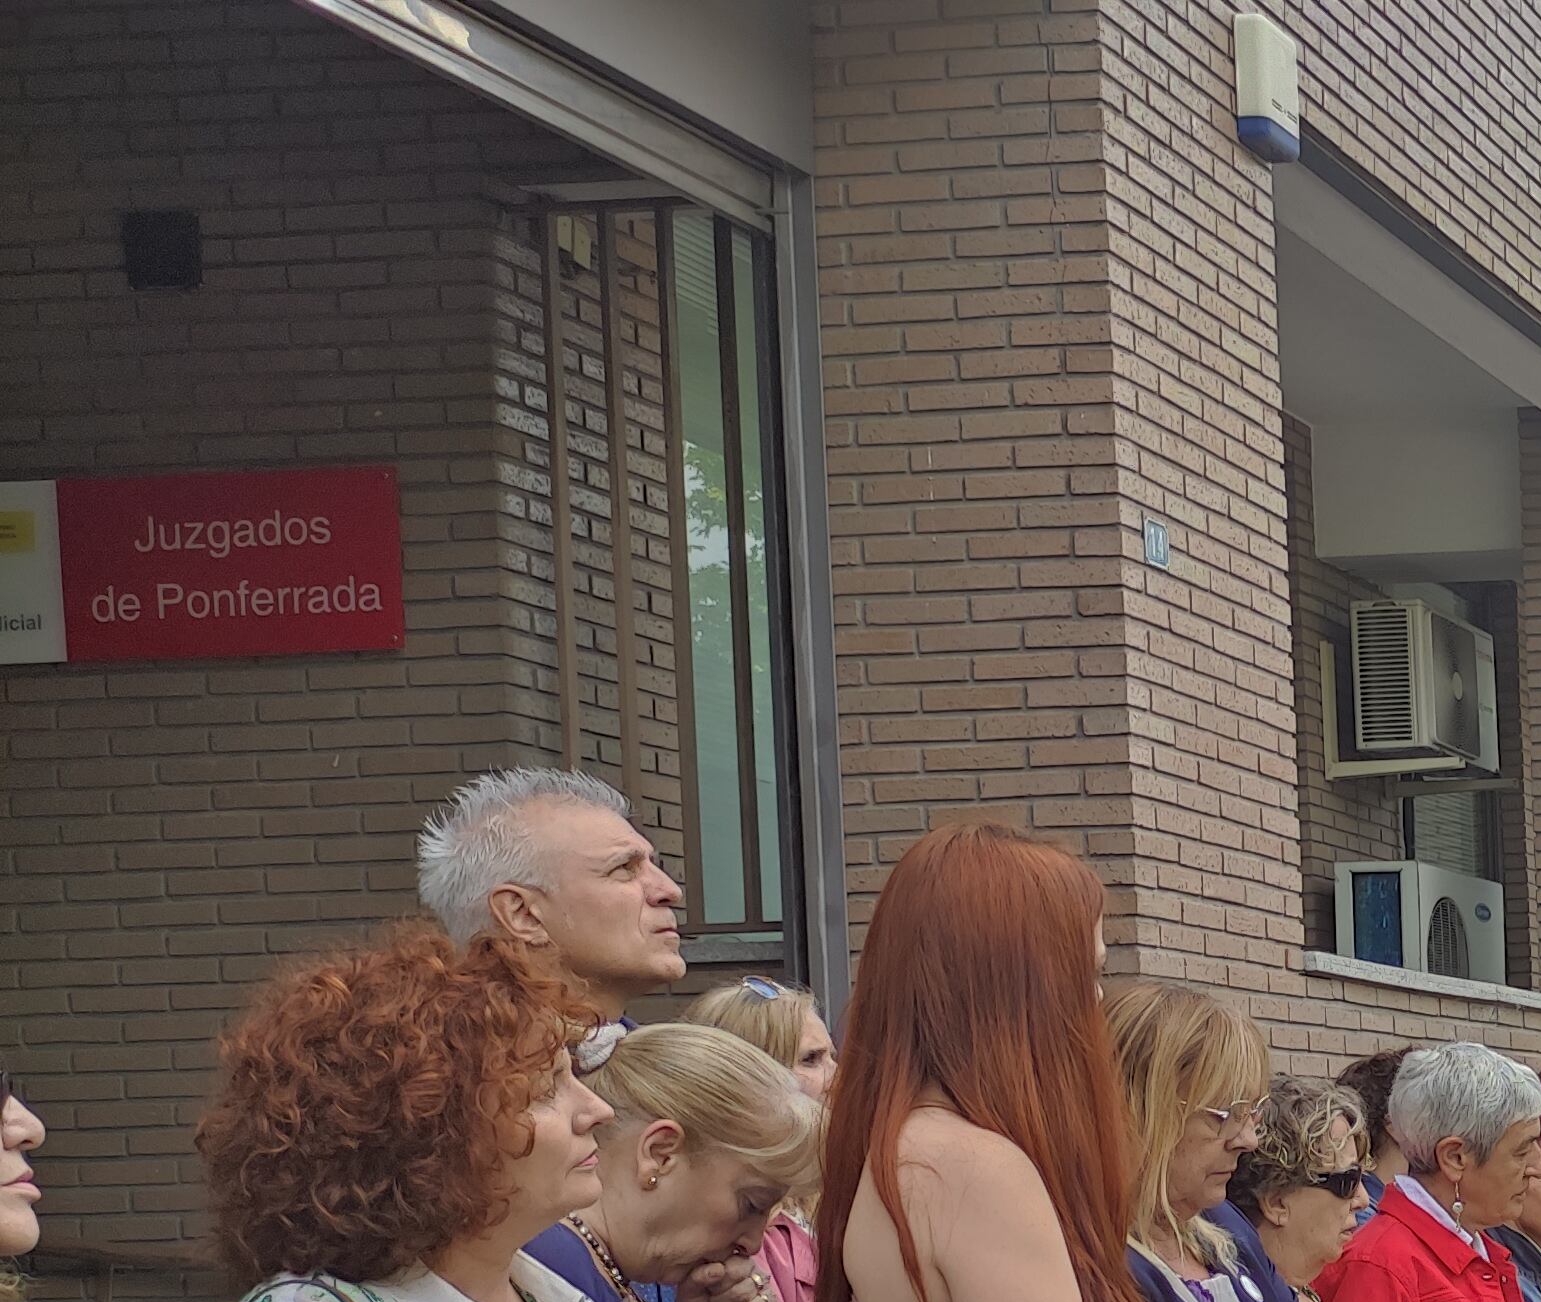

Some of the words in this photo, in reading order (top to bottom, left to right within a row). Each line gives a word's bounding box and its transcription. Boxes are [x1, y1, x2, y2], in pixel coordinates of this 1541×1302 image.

[134, 509, 332, 558] Juzgados
[91, 584, 142, 623] de
[156, 575, 383, 620] Ponferrada
